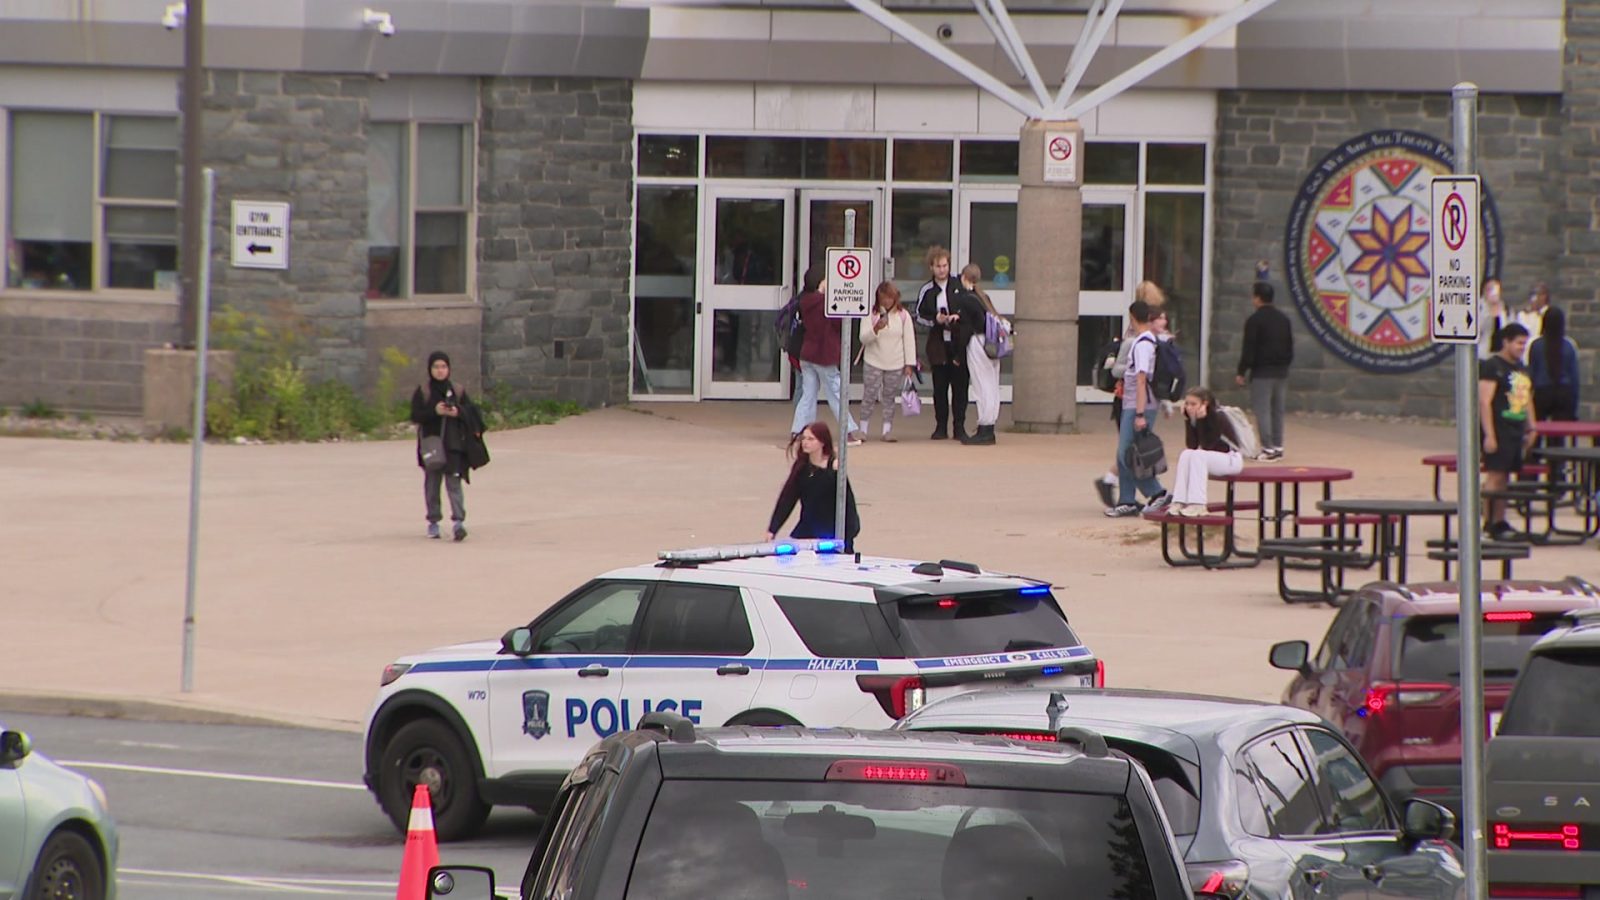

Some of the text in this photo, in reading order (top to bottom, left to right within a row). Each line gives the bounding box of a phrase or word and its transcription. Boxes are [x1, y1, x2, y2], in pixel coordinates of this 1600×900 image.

[236, 225, 284, 238] ENTRANCE
[1449, 258, 1460, 271] NO
[1439, 275, 1471, 288] PARKING
[1439, 292, 1471, 305] ANYTIME
[943, 655, 1001, 667] EMERGENCY
[1036, 650, 1058, 660] CALL
[1057, 649, 1071, 658] 911
[807, 658, 860, 671] HALIFAX
[467, 689, 487, 701] W70
